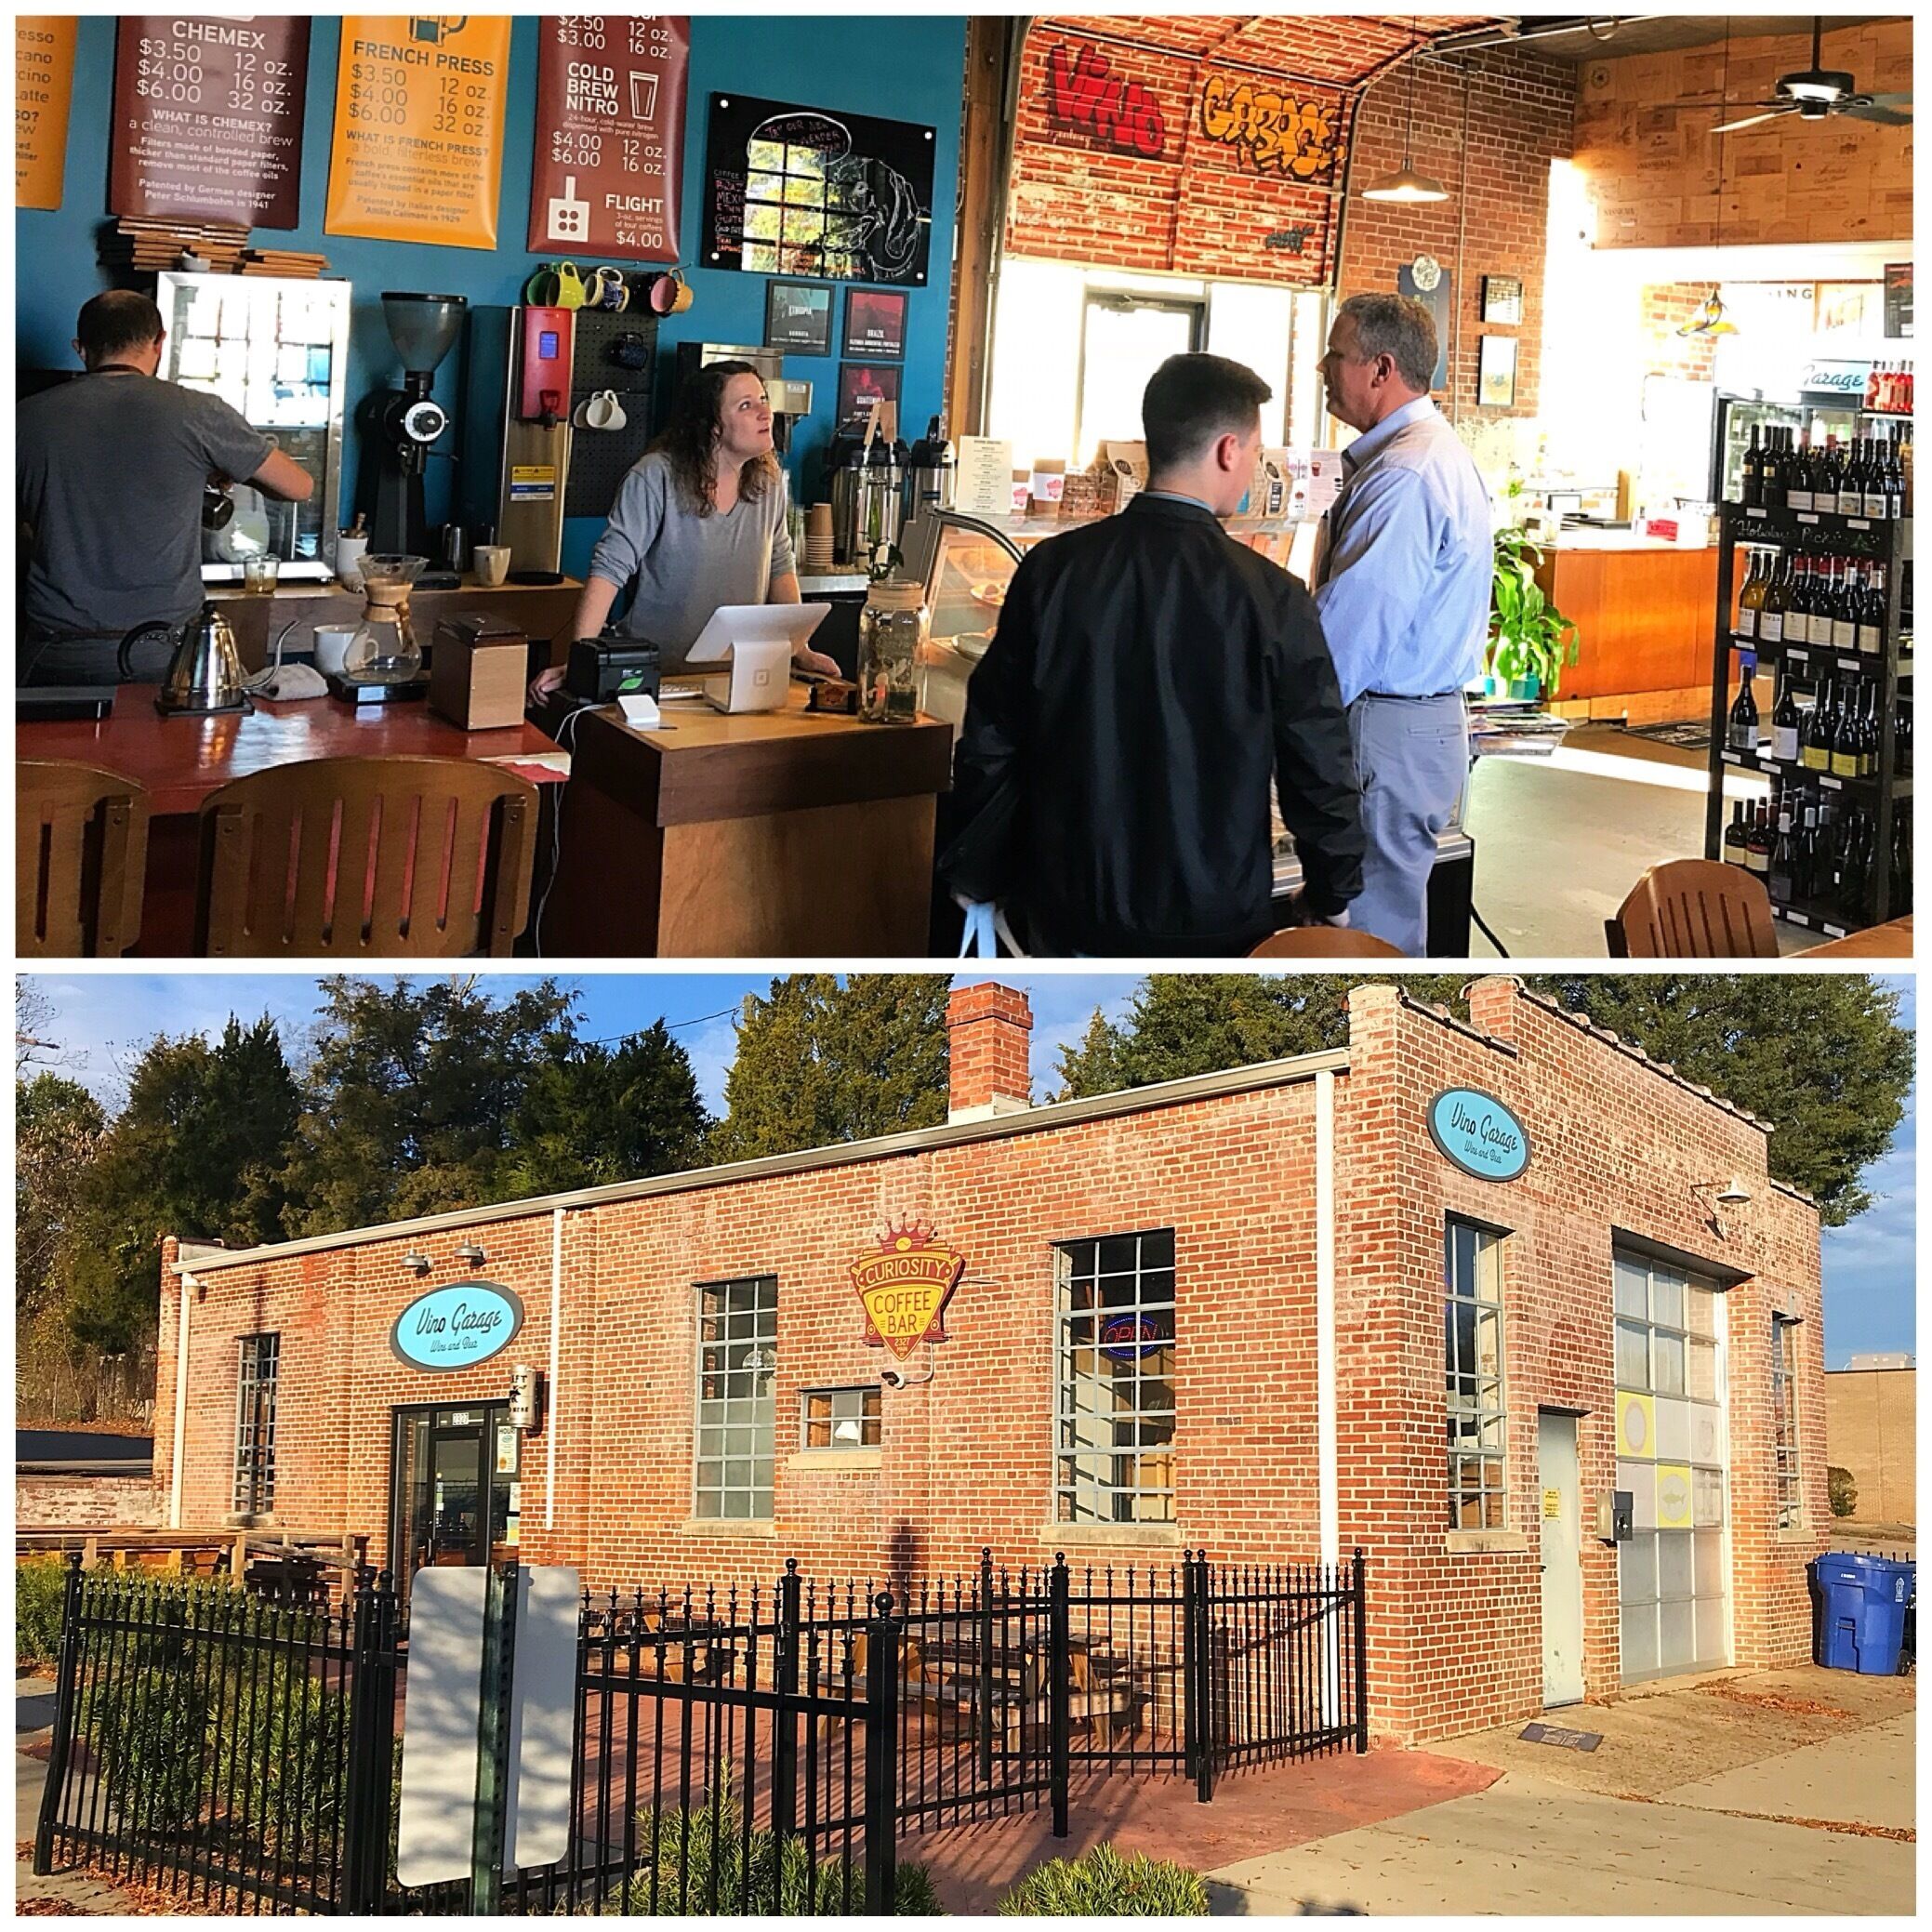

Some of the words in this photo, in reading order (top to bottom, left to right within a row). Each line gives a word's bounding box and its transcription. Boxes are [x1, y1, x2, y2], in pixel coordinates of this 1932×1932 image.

[173, 20, 265, 50] CHEMEX
[558, 16, 604, 32] $2.50
[629, 20, 645, 37] 12
[651, 29, 673, 43] oz.
[558, 29, 605, 50] $3.00
[629, 38, 645, 54] 16
[650, 46, 672, 60] oz.
[139, 37, 201, 62] $3.50
[234, 52, 257, 71] 12
[264, 61, 293, 76] oz.
[353, 40, 430, 66] FRENCH
[436, 53, 495, 76] PRESS
[138, 59, 203, 84] $4.00
[234, 73, 255, 91] 16
[262, 82, 291, 96] oz.
[351, 63, 406, 86] $3.50
[440, 76, 459, 95] 12
[465, 86, 491, 100] oz.
[568, 62, 614, 82] COLD
[137, 79, 201, 103] $6.00
[228, 91, 253, 111] 32
[261, 99, 290, 115] oz.
[567, 78, 619, 99] BREW
[350, 84, 407, 106] $4.00
[439, 97, 457, 115] 16
[465, 104, 490, 119] oz.
[566, 95, 619, 115] NITRO
[152, 109, 191, 123] WHAT
[195, 115, 208, 125] IS
[212, 117, 271, 132] CHEMEX?
[349, 102, 406, 126] $6.00
[433, 113, 456, 132] 32
[463, 123, 489, 138] oz.
[562, 121, 597, 132] dispensed
[600, 125, 614, 134] with
[632, 128, 659, 139] nitrogen
[638, 123, 655, 132] brew
[129, 119, 136, 128] a
[142, 120, 183, 136] clean,
[188, 126, 254, 143] controlled
[258, 133, 293, 147] brew
[346, 130, 379, 141] WHAT
[383, 135, 394, 144] IS
[399, 136, 443, 151] FRENCH
[447, 143, 489, 156] PRESS?
[552, 130, 602, 151] $4.00
[623, 139, 640, 155] 12
[644, 146, 668, 159] oz.
[129, 147, 162, 157] thicker
[165, 151, 185, 160] than
[189, 153, 229, 165] standard
[232, 158, 257, 168] paper
[260, 160, 289, 171] filters,
[141, 137, 171, 148] Filters
[175, 141, 199, 151] made
[203, 143, 213, 152] of
[216, 145, 248, 156] bonded
[251, 152, 279, 161] paper,
[351, 143, 359, 152] a
[364, 143, 392, 157] bold,
[398, 147, 448, 163] filterless
[452, 156, 482, 167] brew
[139, 160, 173, 169] remove
[177, 162, 199, 172] most
[203, 165, 213, 173] of
[216, 165, 229, 175] the
[232, 167, 260, 179] coffee
[262, 171, 279, 179] oils
[346, 157, 375, 167] French
[377, 162, 401, 172] press
[402, 165, 437, 176] contains
[440, 170, 459, 179] more
[552, 147, 601, 167] $6.00
[623, 156, 639, 172] 16
[643, 164, 666, 176] oz.
[139, 179, 181, 192] Patented
[189, 183, 195, 194] by
[199, 185, 234, 196] German
[236, 188, 275, 201] designer
[348, 179, 377, 190] usually
[380, 183, 411, 193] trapped
[431, 189, 454, 198] paper
[457, 190, 476, 199] filter
[389, 173, 426, 184] essential
[428, 177, 442, 186] oils
[444, 179, 459, 187] that
[145, 190, 170, 201] Peter
[236, 199, 246, 207] in
[249, 200, 270, 209] 1941
[357, 195, 394, 206] Patented
[396, 199, 405, 208] by
[409, 201, 433, 211] Italian
[435, 205, 470, 216] designer
[606, 193, 664, 214] FLIGHT
[441, 215, 461, 223] 1929
[615, 220, 622, 229] of
[625, 221, 637, 230] four
[639, 222, 662, 232] coffees
[634, 214, 663, 223] servings
[616, 231, 662, 249] $4.00
[1802, 364, 1865, 390] Garage
[1451, 1102, 1476, 1134] Vino
[1480, 1114, 1517, 1154] Garage
[1463, 1140, 1478, 1155] Wine
[1478, 1147, 1489, 1158] and
[866, 1259, 946, 1284] CURIOSITY
[874, 1290, 932, 1314] COFFEE
[417, 1307, 446, 1335] Vino
[451, 1303, 502, 1336] Garage
[888, 1315, 917, 1333] BAR
[894, 1337, 909, 1346] 2327
[1104, 1324, 1158, 1343] OPEN
[430, 1340, 446, 1352] Wine
[448, 1339, 461, 1350] and
